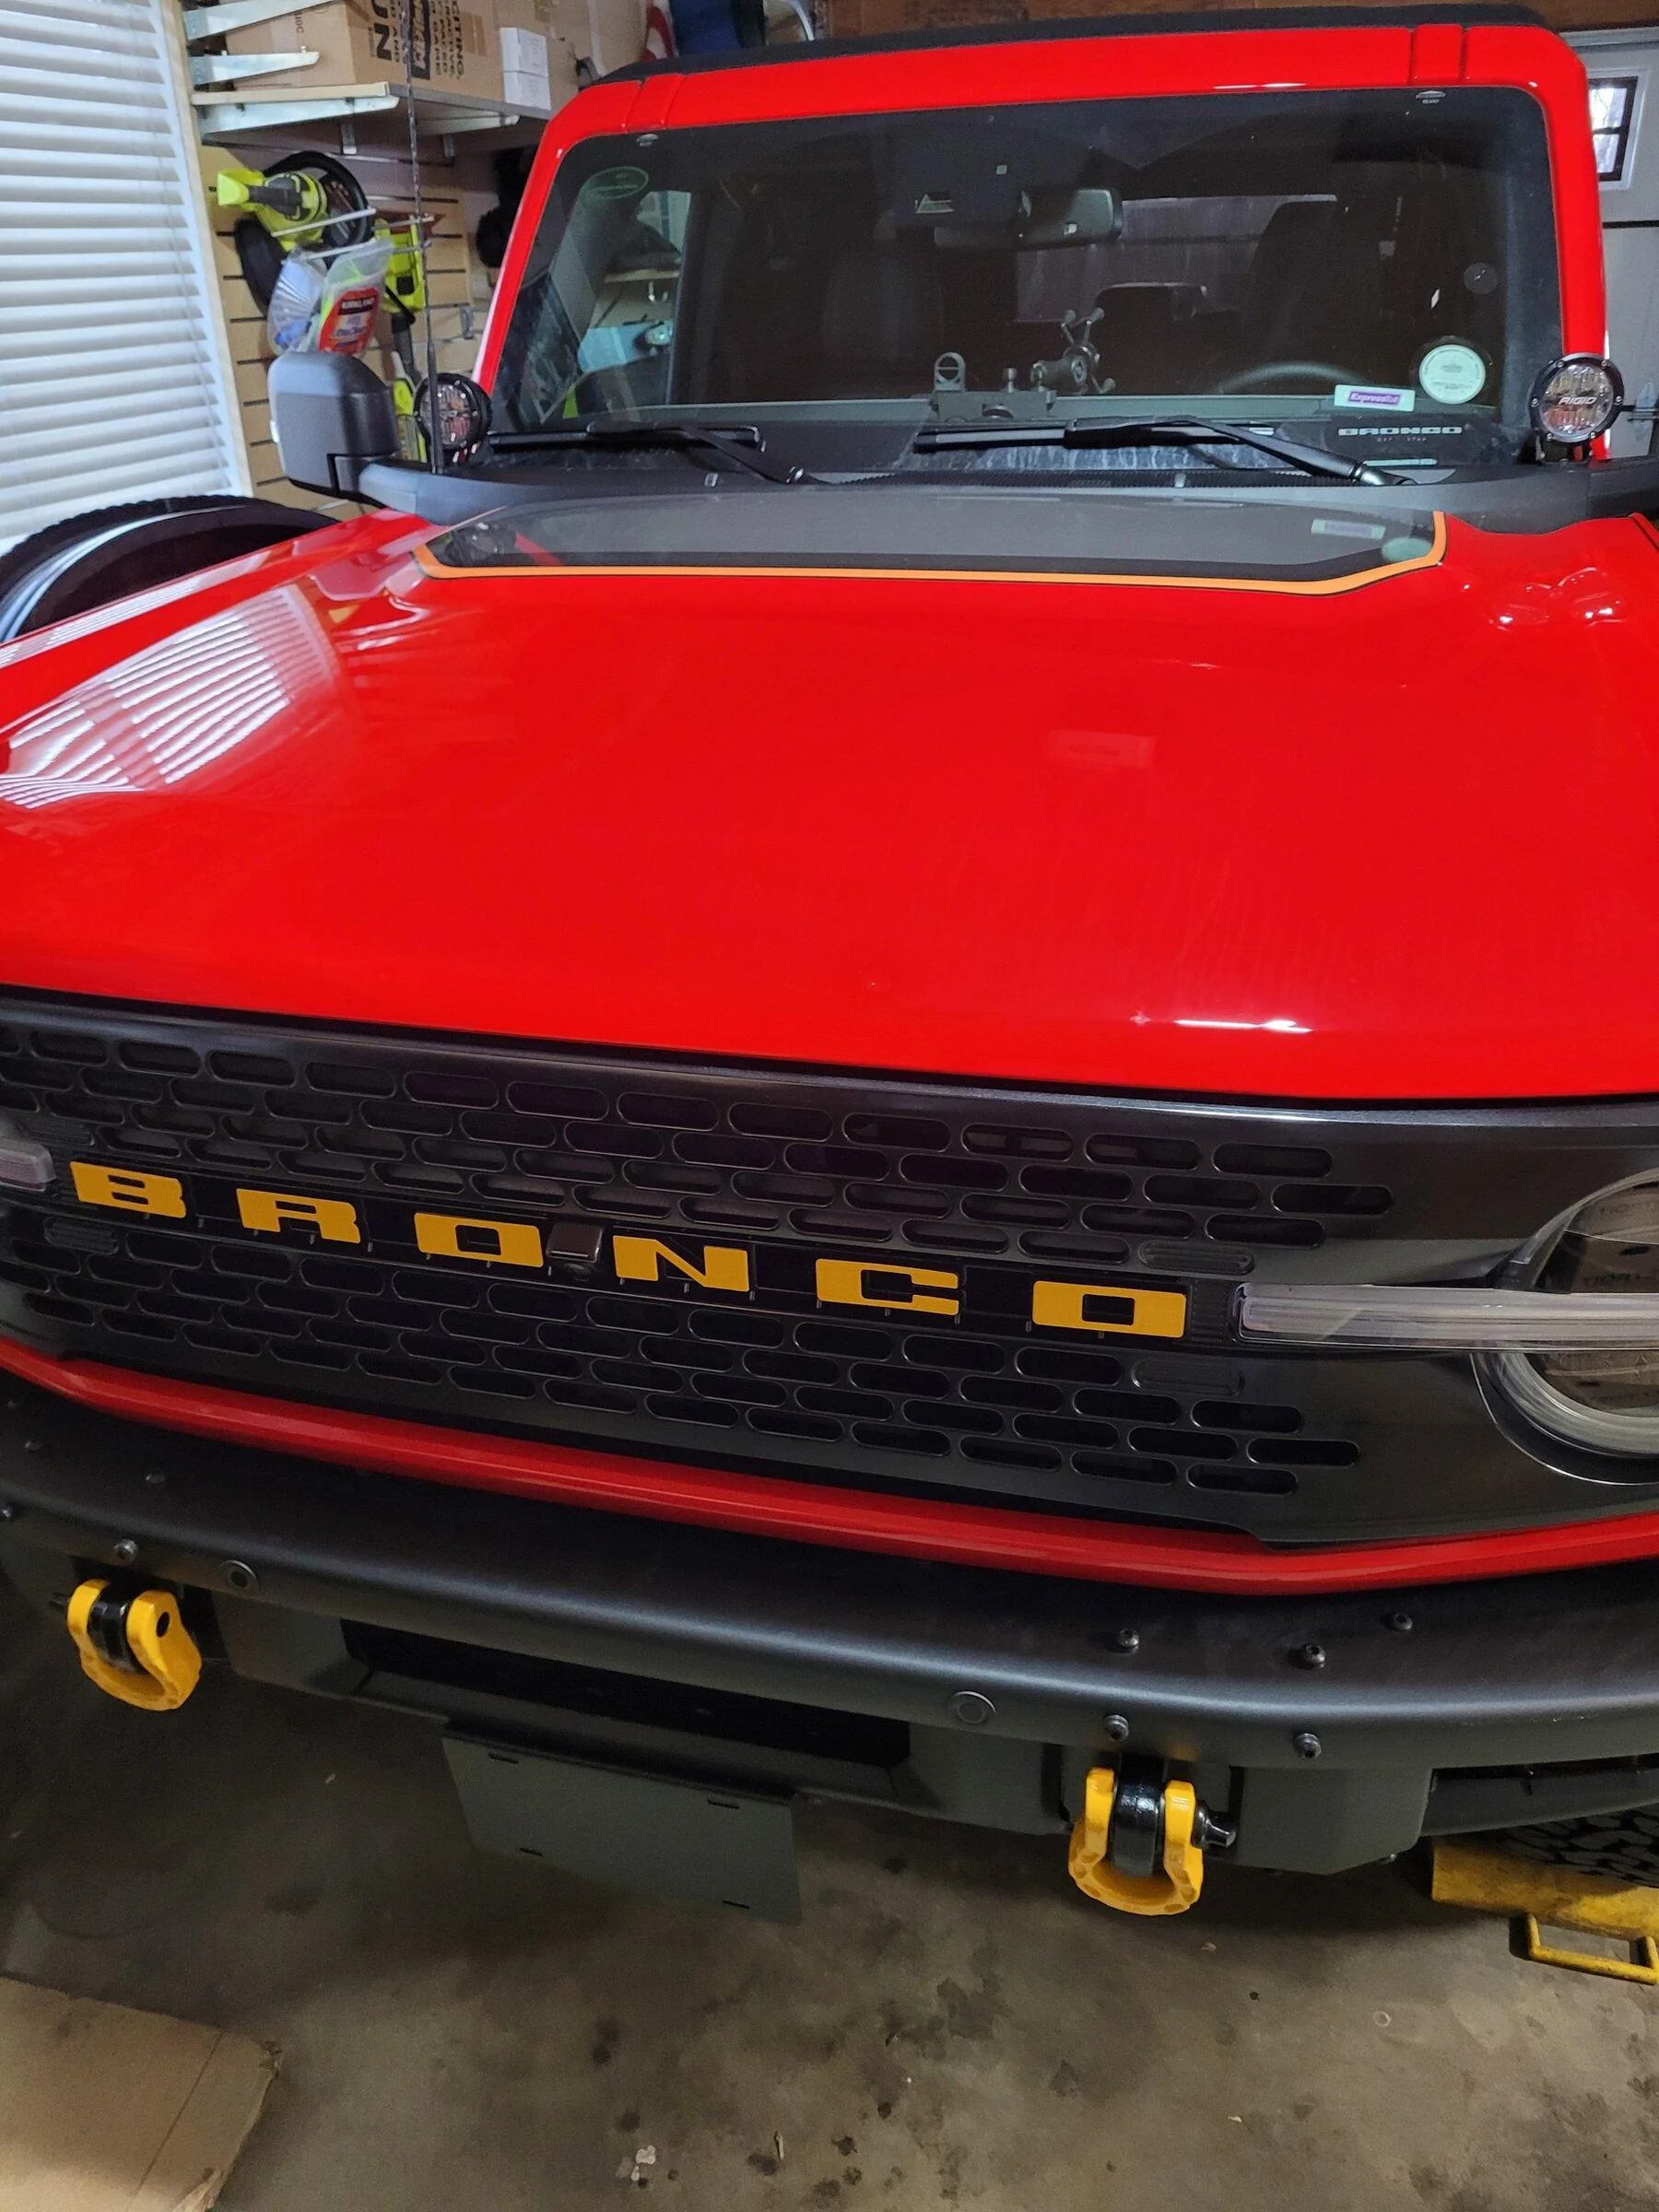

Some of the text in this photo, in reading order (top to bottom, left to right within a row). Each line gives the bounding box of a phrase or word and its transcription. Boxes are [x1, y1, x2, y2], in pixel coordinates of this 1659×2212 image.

[1558, 396, 1597, 405] RIGID
[1337, 426, 1463, 436] BRONCO
[69, 1160, 1187, 1339] BRONCO
